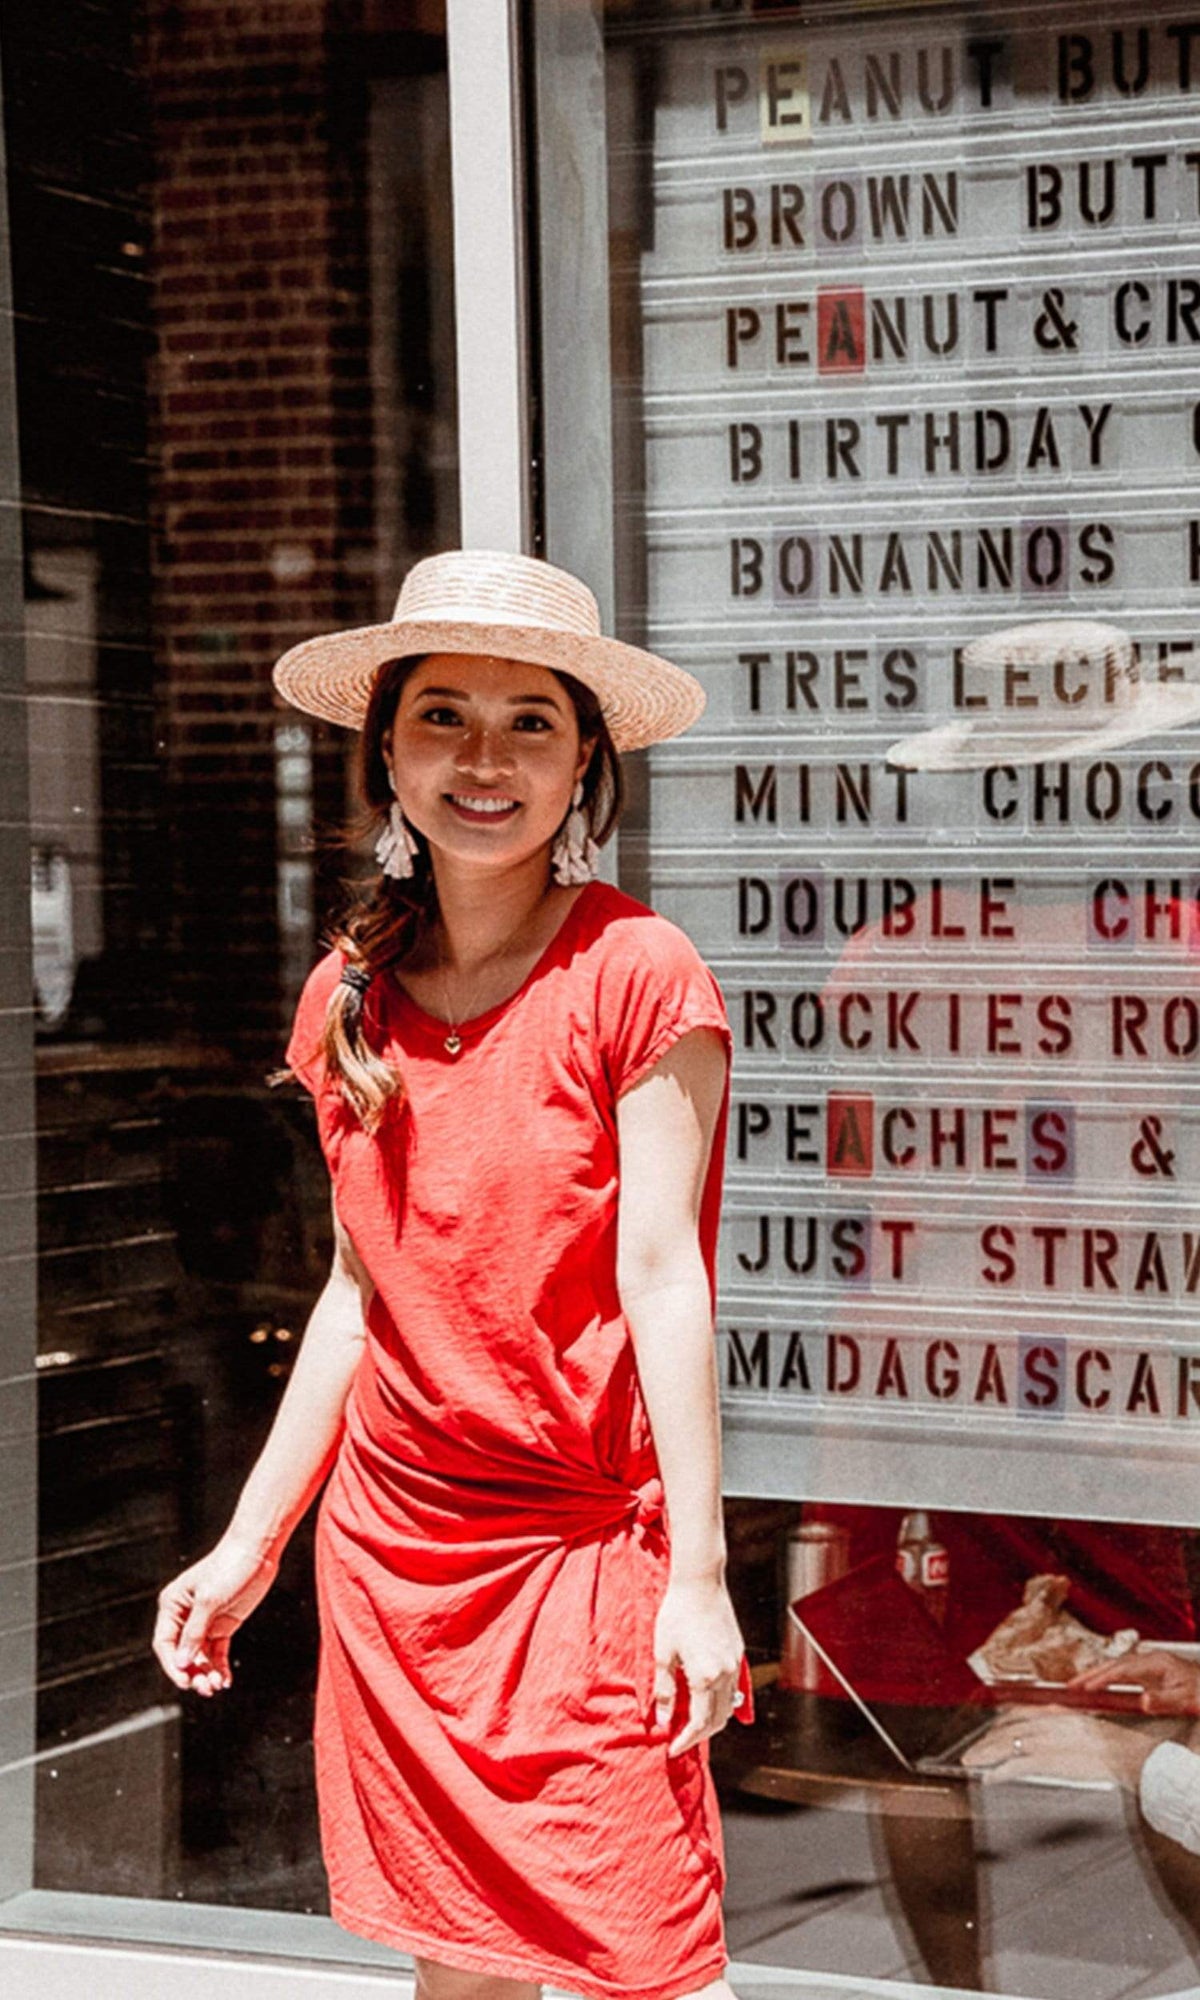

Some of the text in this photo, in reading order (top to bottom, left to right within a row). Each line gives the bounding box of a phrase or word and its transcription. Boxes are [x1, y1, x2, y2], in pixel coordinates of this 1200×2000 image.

[713, 25, 1200, 132] PEANUT BUT
[722, 171, 958, 250] BROWN
[726, 279, 1200, 369] PEANUT & CR
[728, 404, 1113, 483] BIRTHDAY
[730, 522, 1116, 597] BONANNOS
[738, 648, 918, 712] TRES
[734, 764, 918, 823] MINT
[738, 877, 1200, 939] DOUBLE CH
[743, 989, 1200, 1057] ROCKIES RO
[737, 1103, 1175, 1177] PEACHES &
[737, 1215, 915, 1280] JUST
[727, 1329, 1200, 1417] MADAGASCAR
